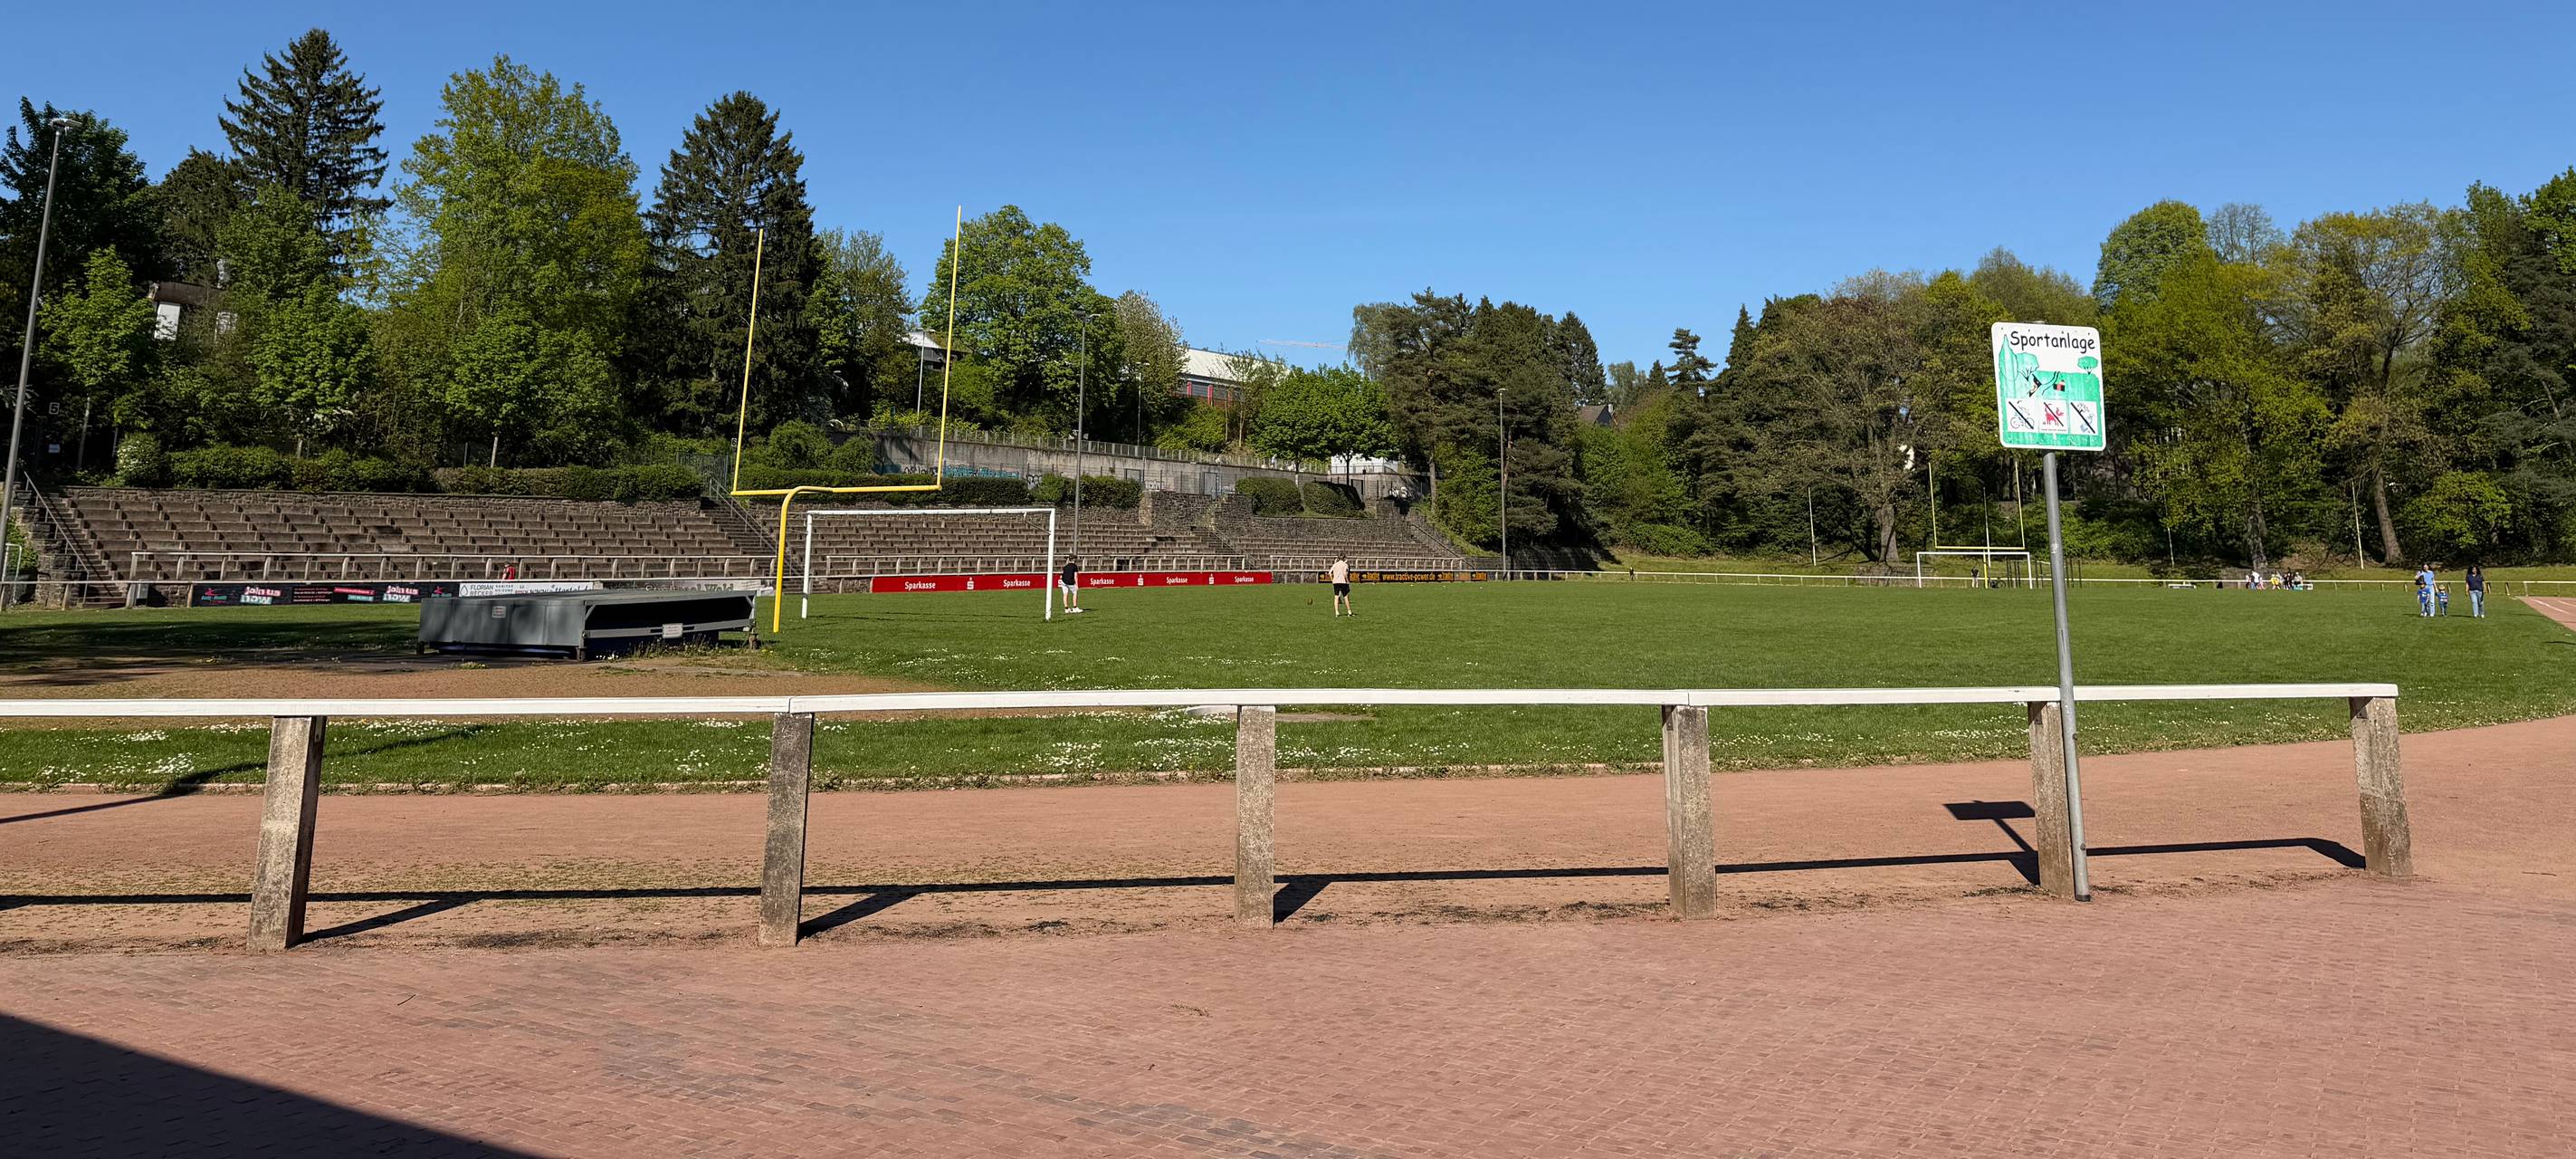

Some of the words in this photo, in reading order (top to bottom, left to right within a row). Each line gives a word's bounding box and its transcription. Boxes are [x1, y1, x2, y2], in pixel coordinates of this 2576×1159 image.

[2009, 330, 2096, 354] Sportanlage
[51, 404, 58, 413] 5
[1090, 578, 1115, 586] Sparkasse
[1166, 576, 1188, 584] Sparkasse
[1234, 575, 1255, 583] Sparkasse
[904, 580, 936, 589] Sparkasse
[1003, 580, 1031, 588] Sparkasse
[240, 594, 272, 604] now
[383, 593, 412, 602] now
